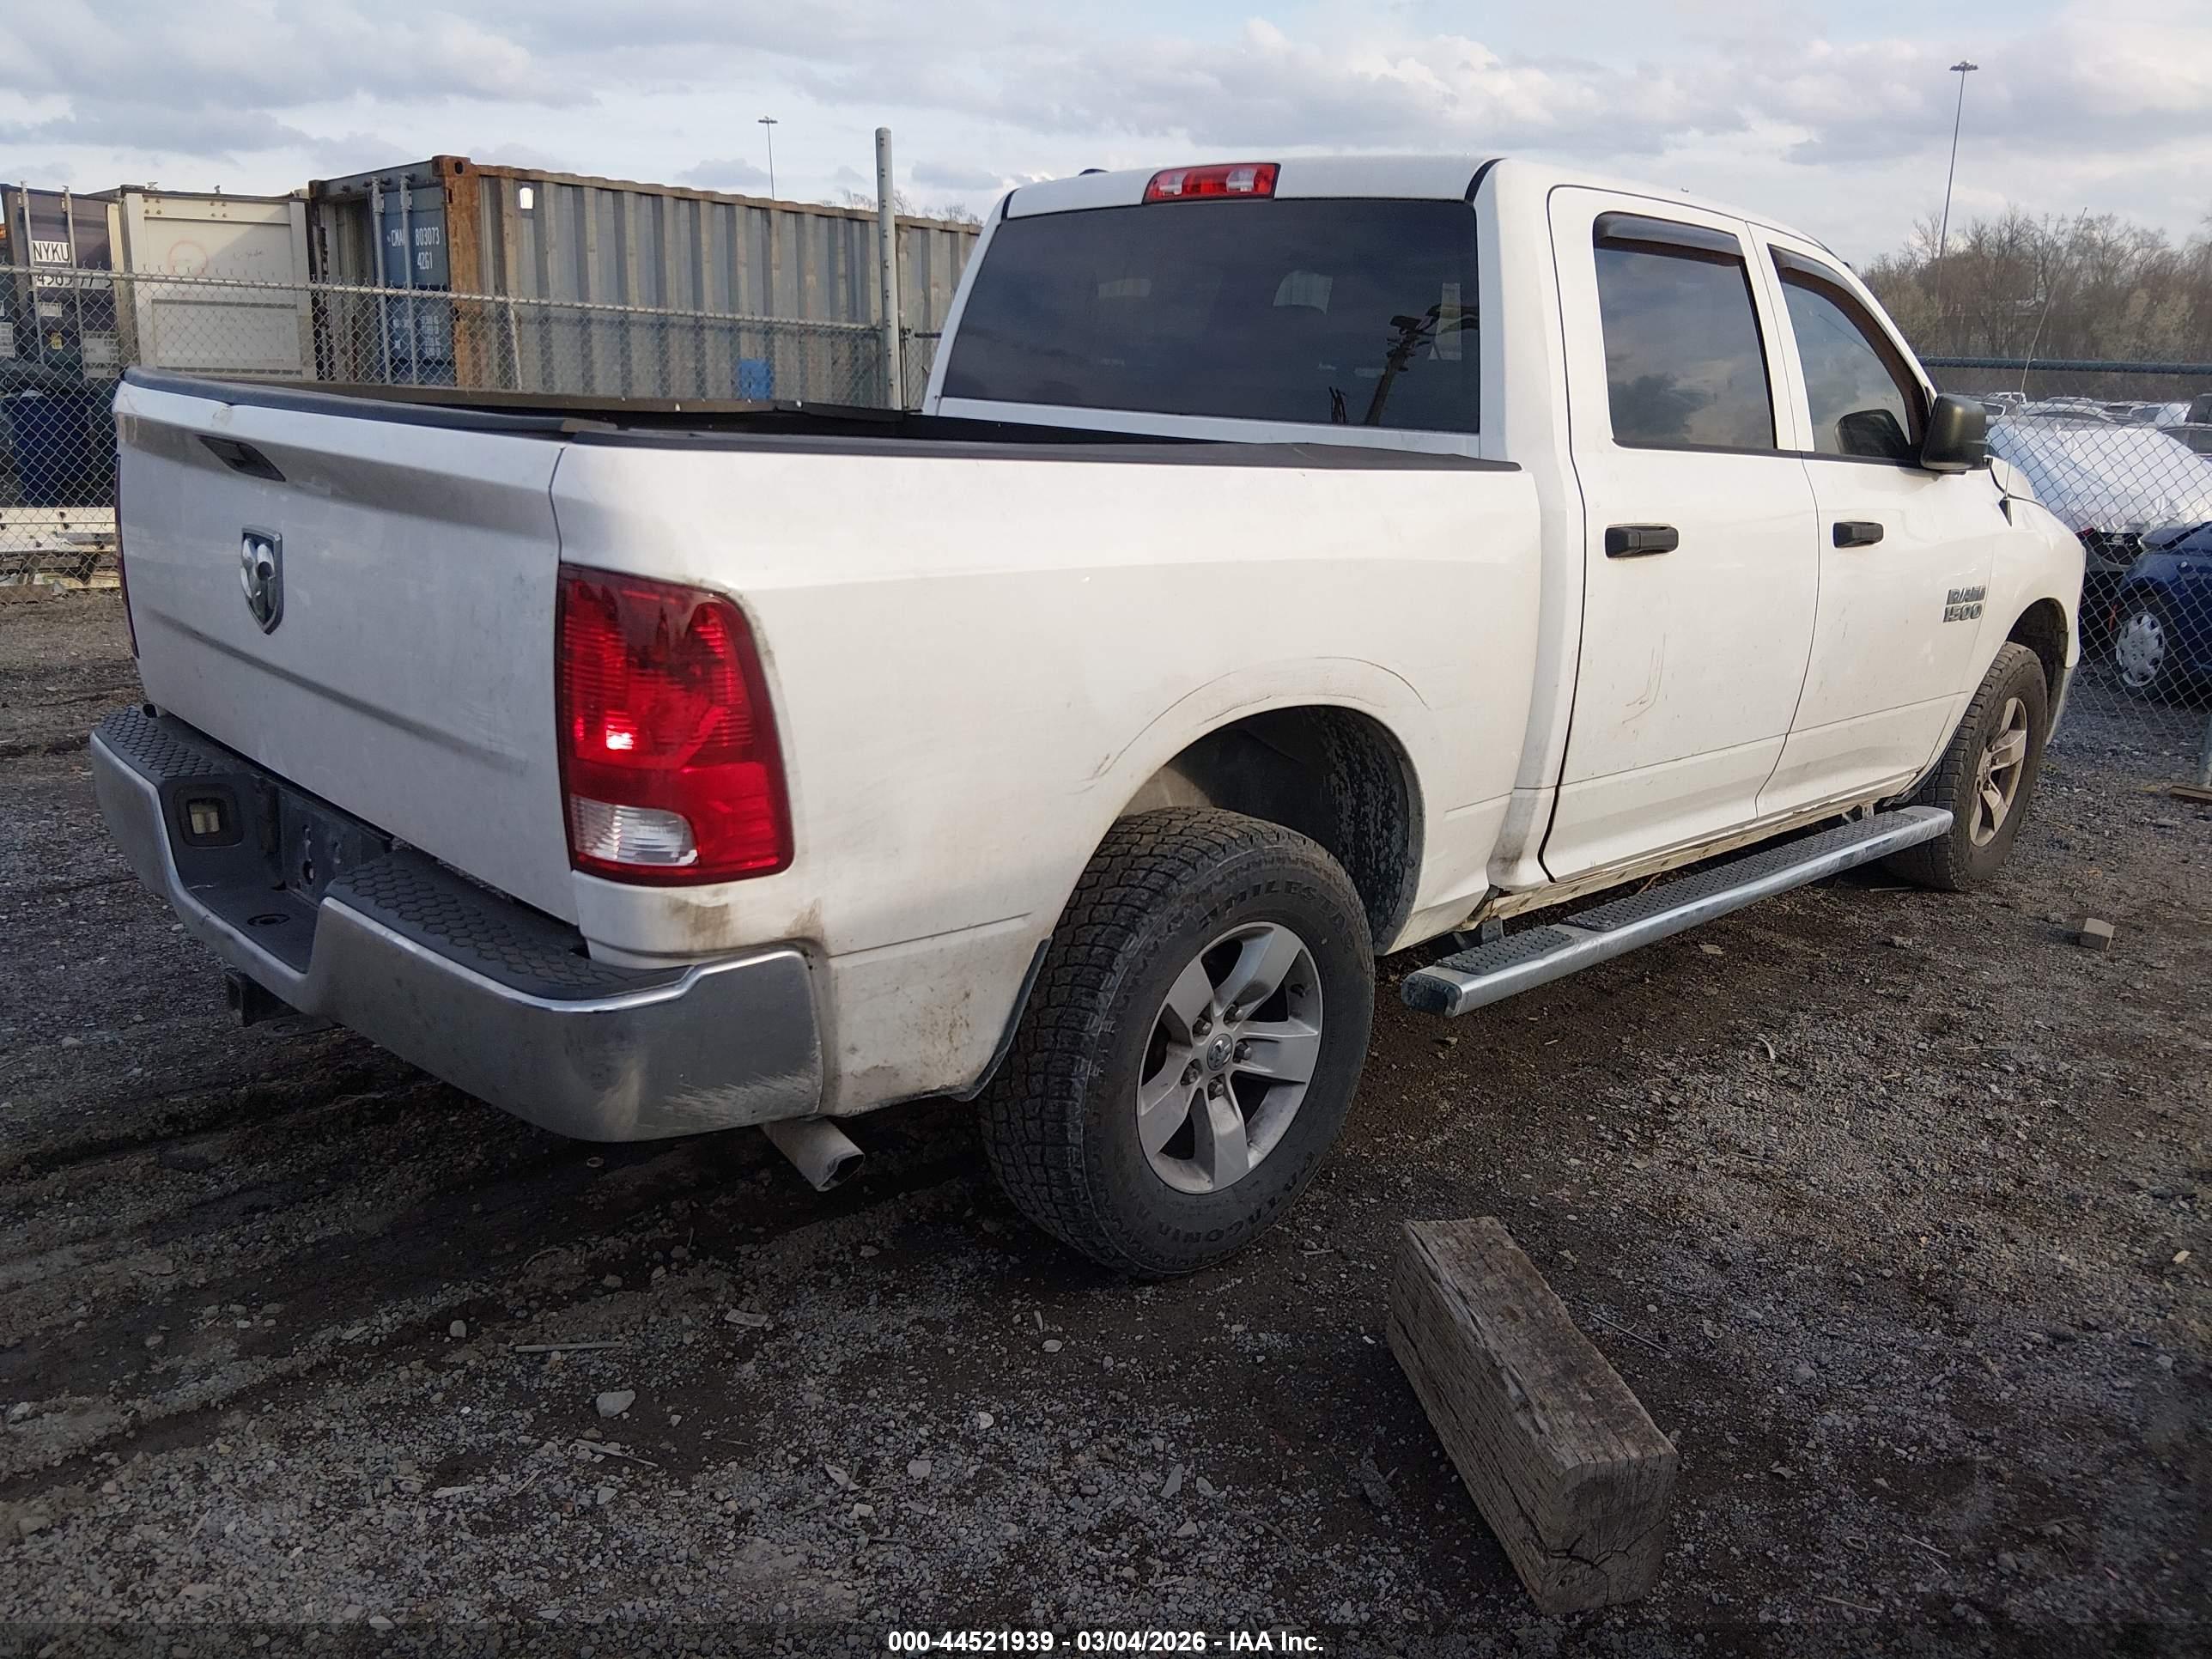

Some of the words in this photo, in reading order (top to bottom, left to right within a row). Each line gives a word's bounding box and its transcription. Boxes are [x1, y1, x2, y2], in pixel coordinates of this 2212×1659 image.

[415, 227, 441, 246] 803073
[33, 241, 70, 261] NYKU
[1946, 586, 1986, 605] RAM
[1942, 603, 1983, 623] 1500
